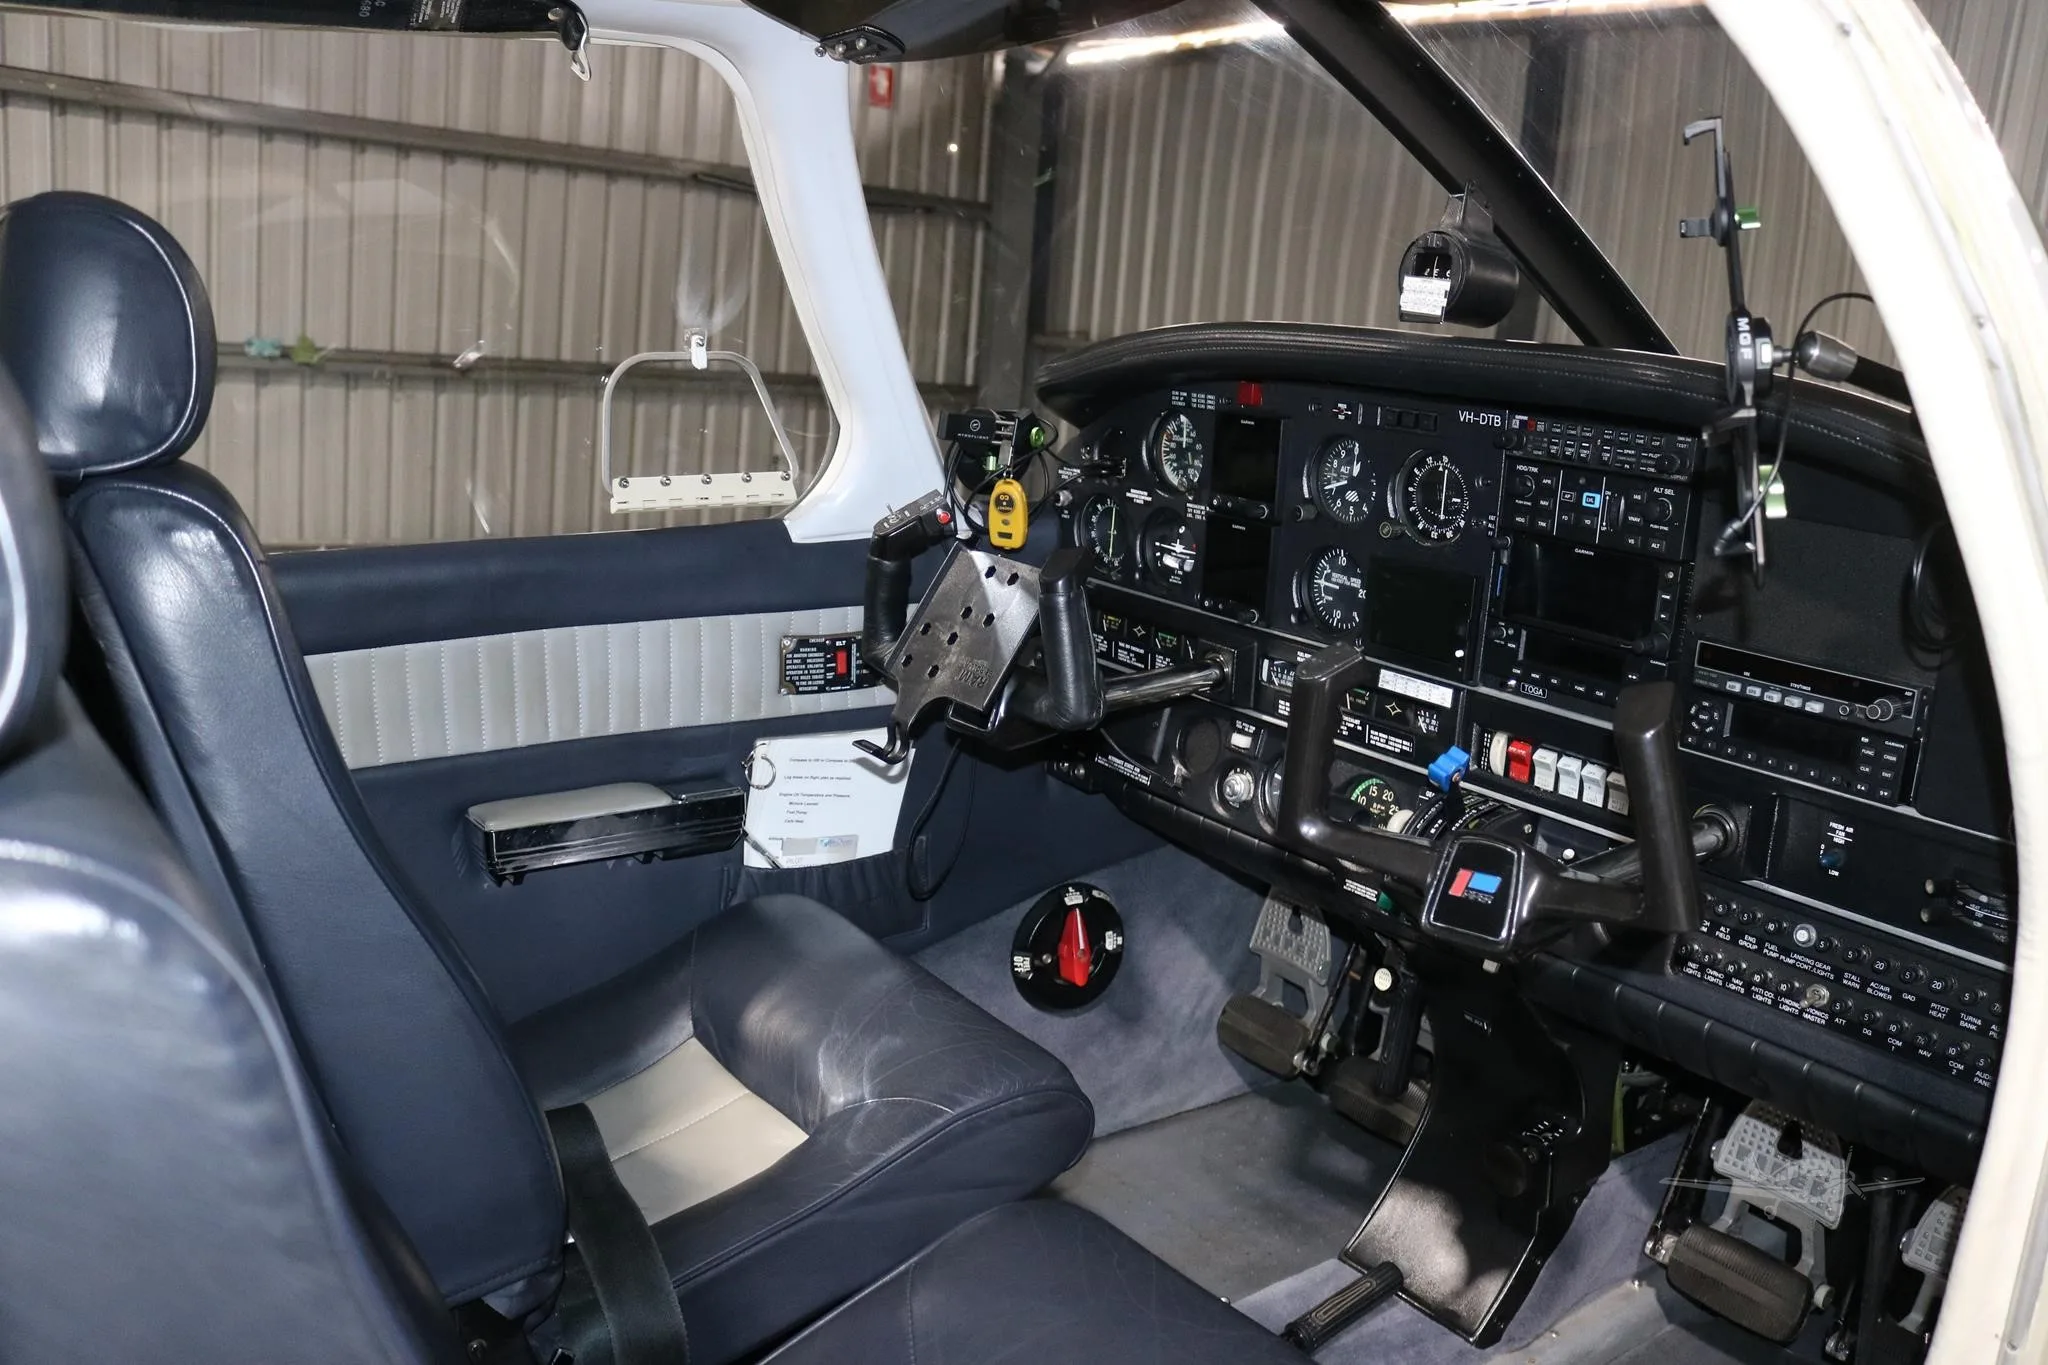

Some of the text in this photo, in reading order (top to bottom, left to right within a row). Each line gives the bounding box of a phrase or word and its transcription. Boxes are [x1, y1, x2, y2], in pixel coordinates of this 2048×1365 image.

[1458, 410, 1501, 427] VH-DTB
[1340, 450, 1346, 458] 9
[1333, 460, 1338, 468] 8
[1516, 464, 1538, 473] HDG/TRK
[1340, 465, 1350, 474] ALT
[1414, 467, 1421, 476] E
[1654, 486, 1676, 496] ALT SEL
[1336, 498, 1342, 507] 6
[1349, 506, 1354, 515] 5
[1362, 504, 1369, 514] 4
[1574, 548, 1594, 556] GARMIN
[1339, 556, 1346, 566] 10
[1333, 609, 1342, 619] 10
[1524, 684, 1544, 696] TOGA
[1369, 785, 1378, 797] 15
[1382, 790, 1394, 802] 20
[1358, 794, 1366, 806] 10
[1388, 804, 1400, 816] 25
[1830, 822, 1844, 830] FRESH
[1833, 836, 1845, 844] HIGH
[1828, 868, 1840, 876] LOW
[1720, 925, 1730, 934] ALT
[1768, 923, 1775, 931] 10
[1716, 930, 1731, 942] FIELD
[1744, 934, 1757, 944] ENG
[1738, 939, 1758, 950] GROUP
[1764, 942, 1778, 952] FUEL
[1763, 948, 1780, 960] PUMP
[1014, 956, 1024, 972] OFF
[1780, 954, 1796, 966] PUMP
[1790, 952, 1832, 972] LANDING GEAR
[1687, 962, 1700, 970] INST
[1728, 964, 1734, 972] 10
[1874, 961, 1885, 970] 20
[1683, 966, 1701, 978] LIGHTS
[1704, 974, 1724, 986] LIGHTS
[1732, 976, 1744, 986] NAV
[1754, 974, 1761, 982] 10
[1844, 972, 1861, 984] STALL
[1726, 981, 1745, 994] LIGHTS
[1780, 984, 1787, 992] 10
[1842, 978, 1860, 990] WARN
[1870, 981, 1890, 994] AC/AIR
[1932, 980, 1942, 990] 20
[1751, 986, 1776, 999] ANTI COL
[1866, 987, 1892, 1001] BLOWER
[1902, 992, 1916, 1002] GAD
[1752, 992, 1772, 1006] LIGHTS
[1778, 1002, 1799, 1015] LIGHTS
[1930, 1002, 1950, 1014] PITOT
[1802, 1012, 1826, 1025] MASTER
[1804, 1007, 1830, 1020] VIONICS
[1928, 1010, 1946, 1020] HEAT
[1834, 1018, 1847, 1026] ATT
[1960, 1020, 1978, 1032] BANK
[1862, 1028, 1872, 1036] DG
[1889, 1024, 1897, 1032] 10
[1888, 1036, 1903, 1048] COM
[1918, 1049, 1932, 1058] NAV
[1948, 1048, 1956, 1056] 10
[1948, 1060, 1964, 1071] COM
[1974, 1077, 1992, 1088] PANE
